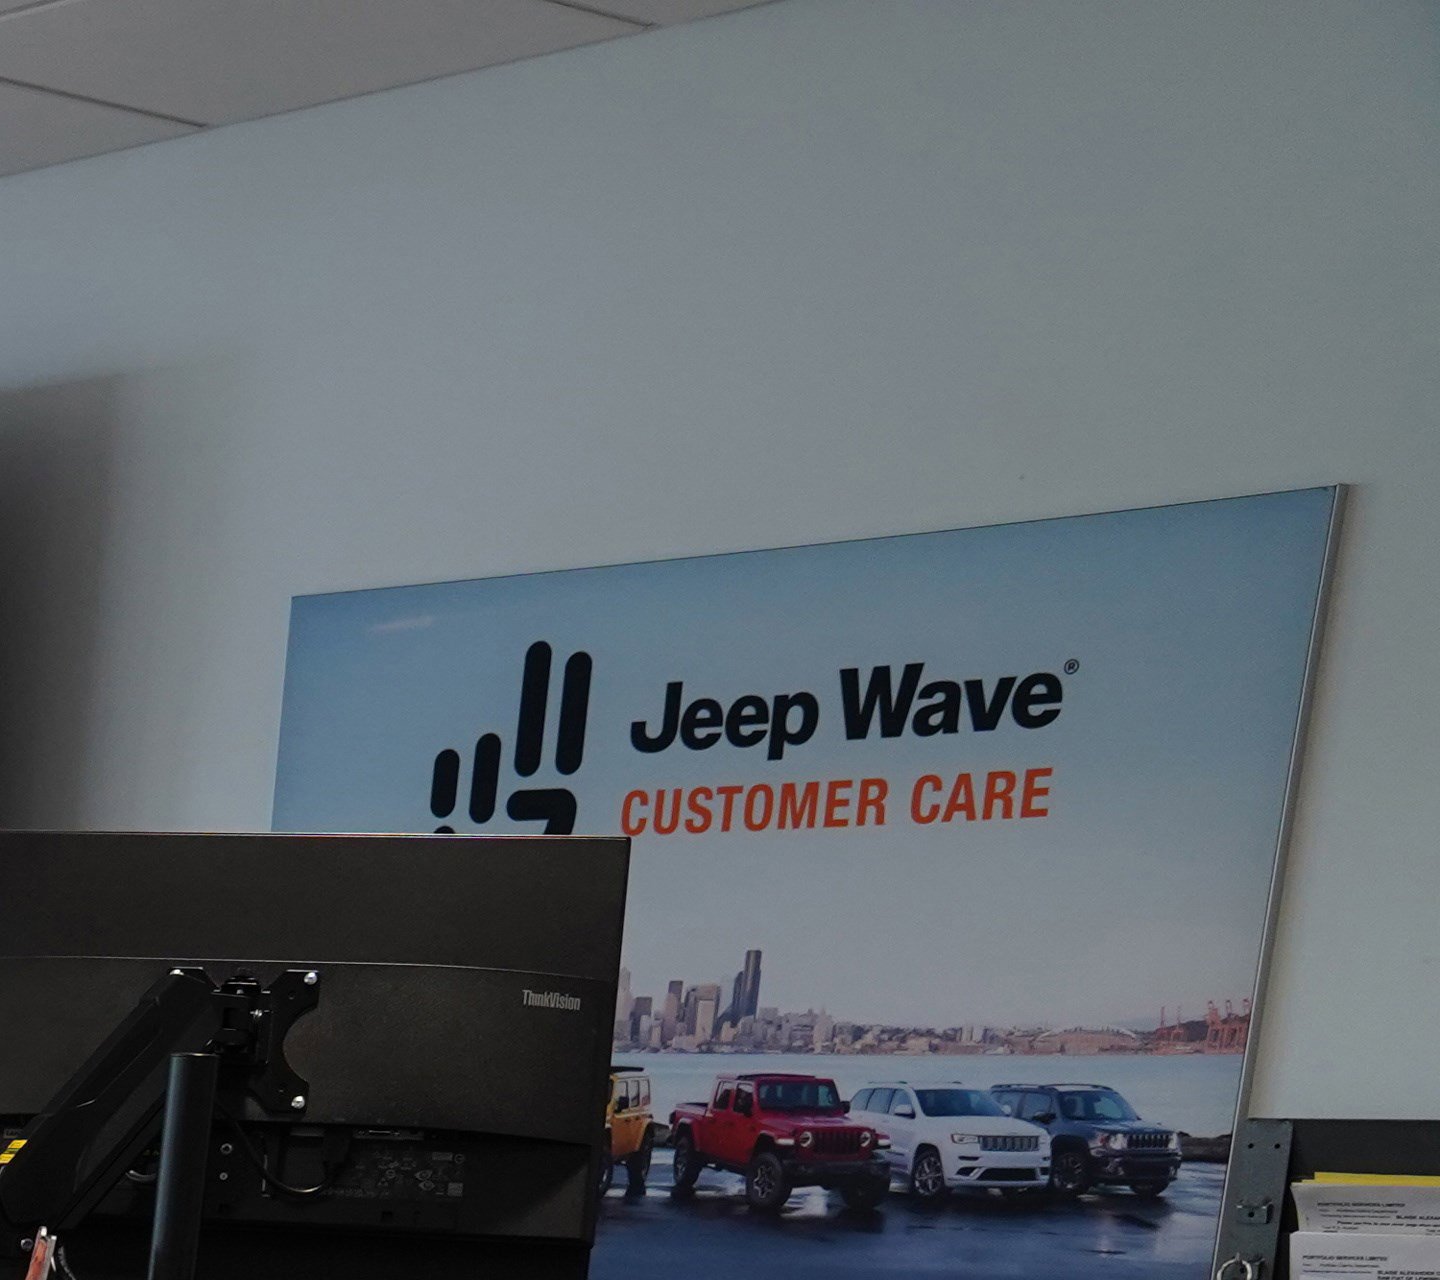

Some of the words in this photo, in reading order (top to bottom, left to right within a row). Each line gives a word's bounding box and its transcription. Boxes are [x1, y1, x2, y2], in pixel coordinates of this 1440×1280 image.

[631, 682, 819, 760] Jeep
[620, 779, 890, 836] CUSTOMER
[909, 768, 1054, 824] CARE
[522, 989, 581, 1011] ThinkVision
